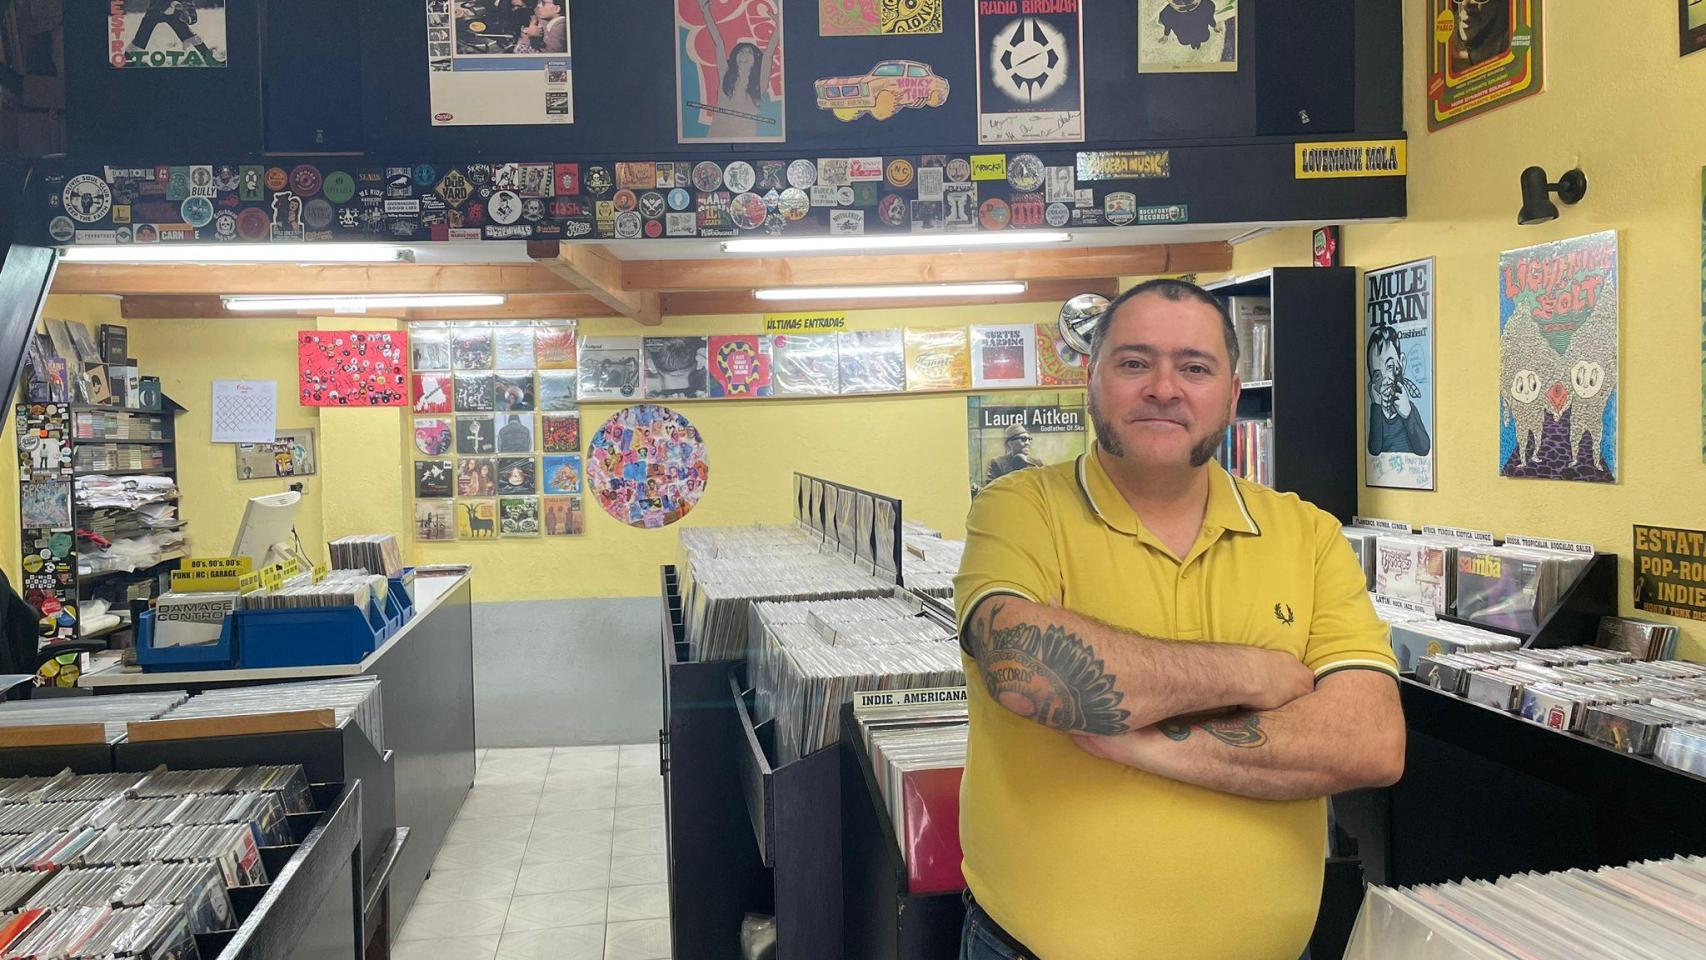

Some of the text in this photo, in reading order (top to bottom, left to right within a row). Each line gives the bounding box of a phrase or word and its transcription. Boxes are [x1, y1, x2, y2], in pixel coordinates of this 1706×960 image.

[980, 0, 1077, 15] RADIO BIRDMAN
[1129, 154, 1163, 175] MUSIC
[1302, 146, 1398, 173] LOVEMONK MOLA
[191, 187, 216, 196] BULLY
[443, 188, 467, 200] YARD
[1369, 264, 1427, 302] MULE
[1367, 292, 1430, 327] TRAIN
[804, 317, 845, 328] ENTRADAS
[985, 409, 1078, 427] Laurel Aitken
[1576, 544, 1593, 553] SALSA
[1635, 527, 1706, 557] ESTAT
[172, 571, 191, 580] PUNK
[210, 569, 237, 578] GARAGE
[1459, 555, 1501, 579] samba
[1640, 556, 1706, 582] POP-RO
[1657, 582, 1706, 608] INDIE
[158, 602, 233, 613] DAMAGE
[1643, 602, 1668, 614] HONKY
[1669, 606, 1691, 619] TONK
[996, 667, 1033, 684] RECORDS
[862, 694, 893, 706] INDIE
[903, 690, 967, 704] AMERICANA
